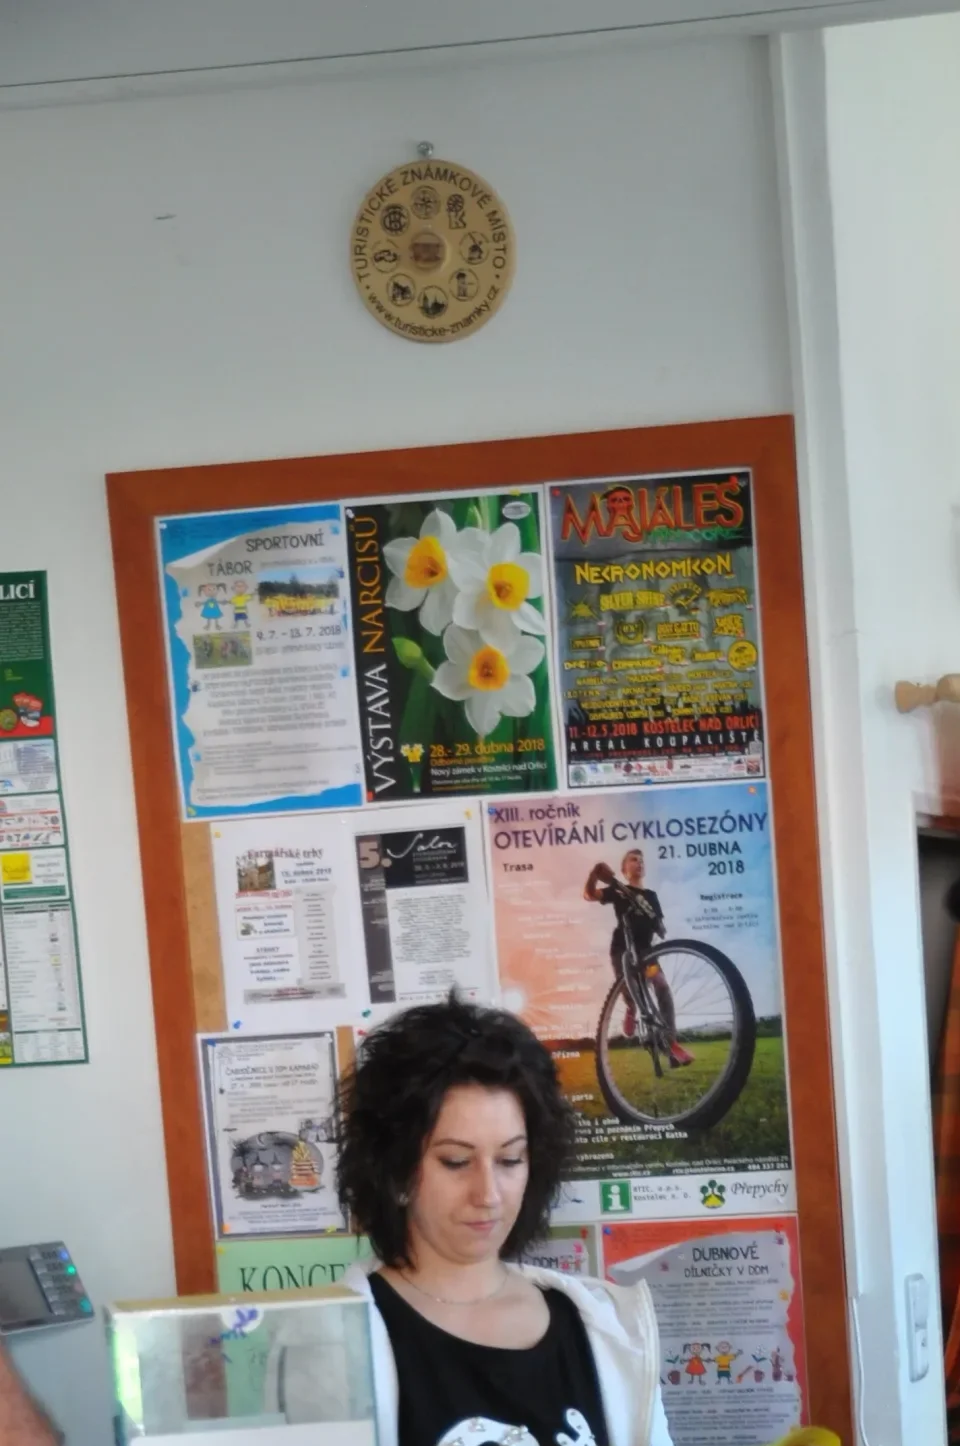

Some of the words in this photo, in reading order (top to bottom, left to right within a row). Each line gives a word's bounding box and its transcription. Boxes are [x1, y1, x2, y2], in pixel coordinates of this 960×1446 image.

[354, 178, 399, 282] TURISTICKÉ
[400, 164, 492, 209] ZNÁMKOVÉ
[487, 209, 507, 270] MÍSTO
[561, 480, 745, 544] MAJÁLES
[245, 528, 324, 552] SPORTOVNÍ
[207, 557, 253, 576] TÁBOR
[574, 552, 733, 585] NECRONOMICON
[349, 515, 387, 654] NARCISŮ
[319, 624, 342, 636] 2018
[366, 663, 397, 793] VÝSTAVA
[643, 718, 695, 735] KOSTELEC
[700, 717, 721, 731] NAD
[726, 712, 759, 730] ORLICÍ
[474, 741, 514, 755] dubna
[517, 738, 545, 752] 2018
[529, 803, 581, 820] ročník
[494, 819, 605, 850] OTEVÍRÁNÍ
[611, 810, 767, 842] CYKLOSEZÓNY
[658, 845, 682, 860] 21.
[686, 840, 742, 858] DUBNA
[502, 863, 534, 873] Trasa
[708, 860, 745, 876] 2018
[731, 1178, 789, 1198] Přepychy
[692, 1240, 760, 1262] DUBNOVÉ
[684, 1263, 733, 1278] DÍLNIČKY
